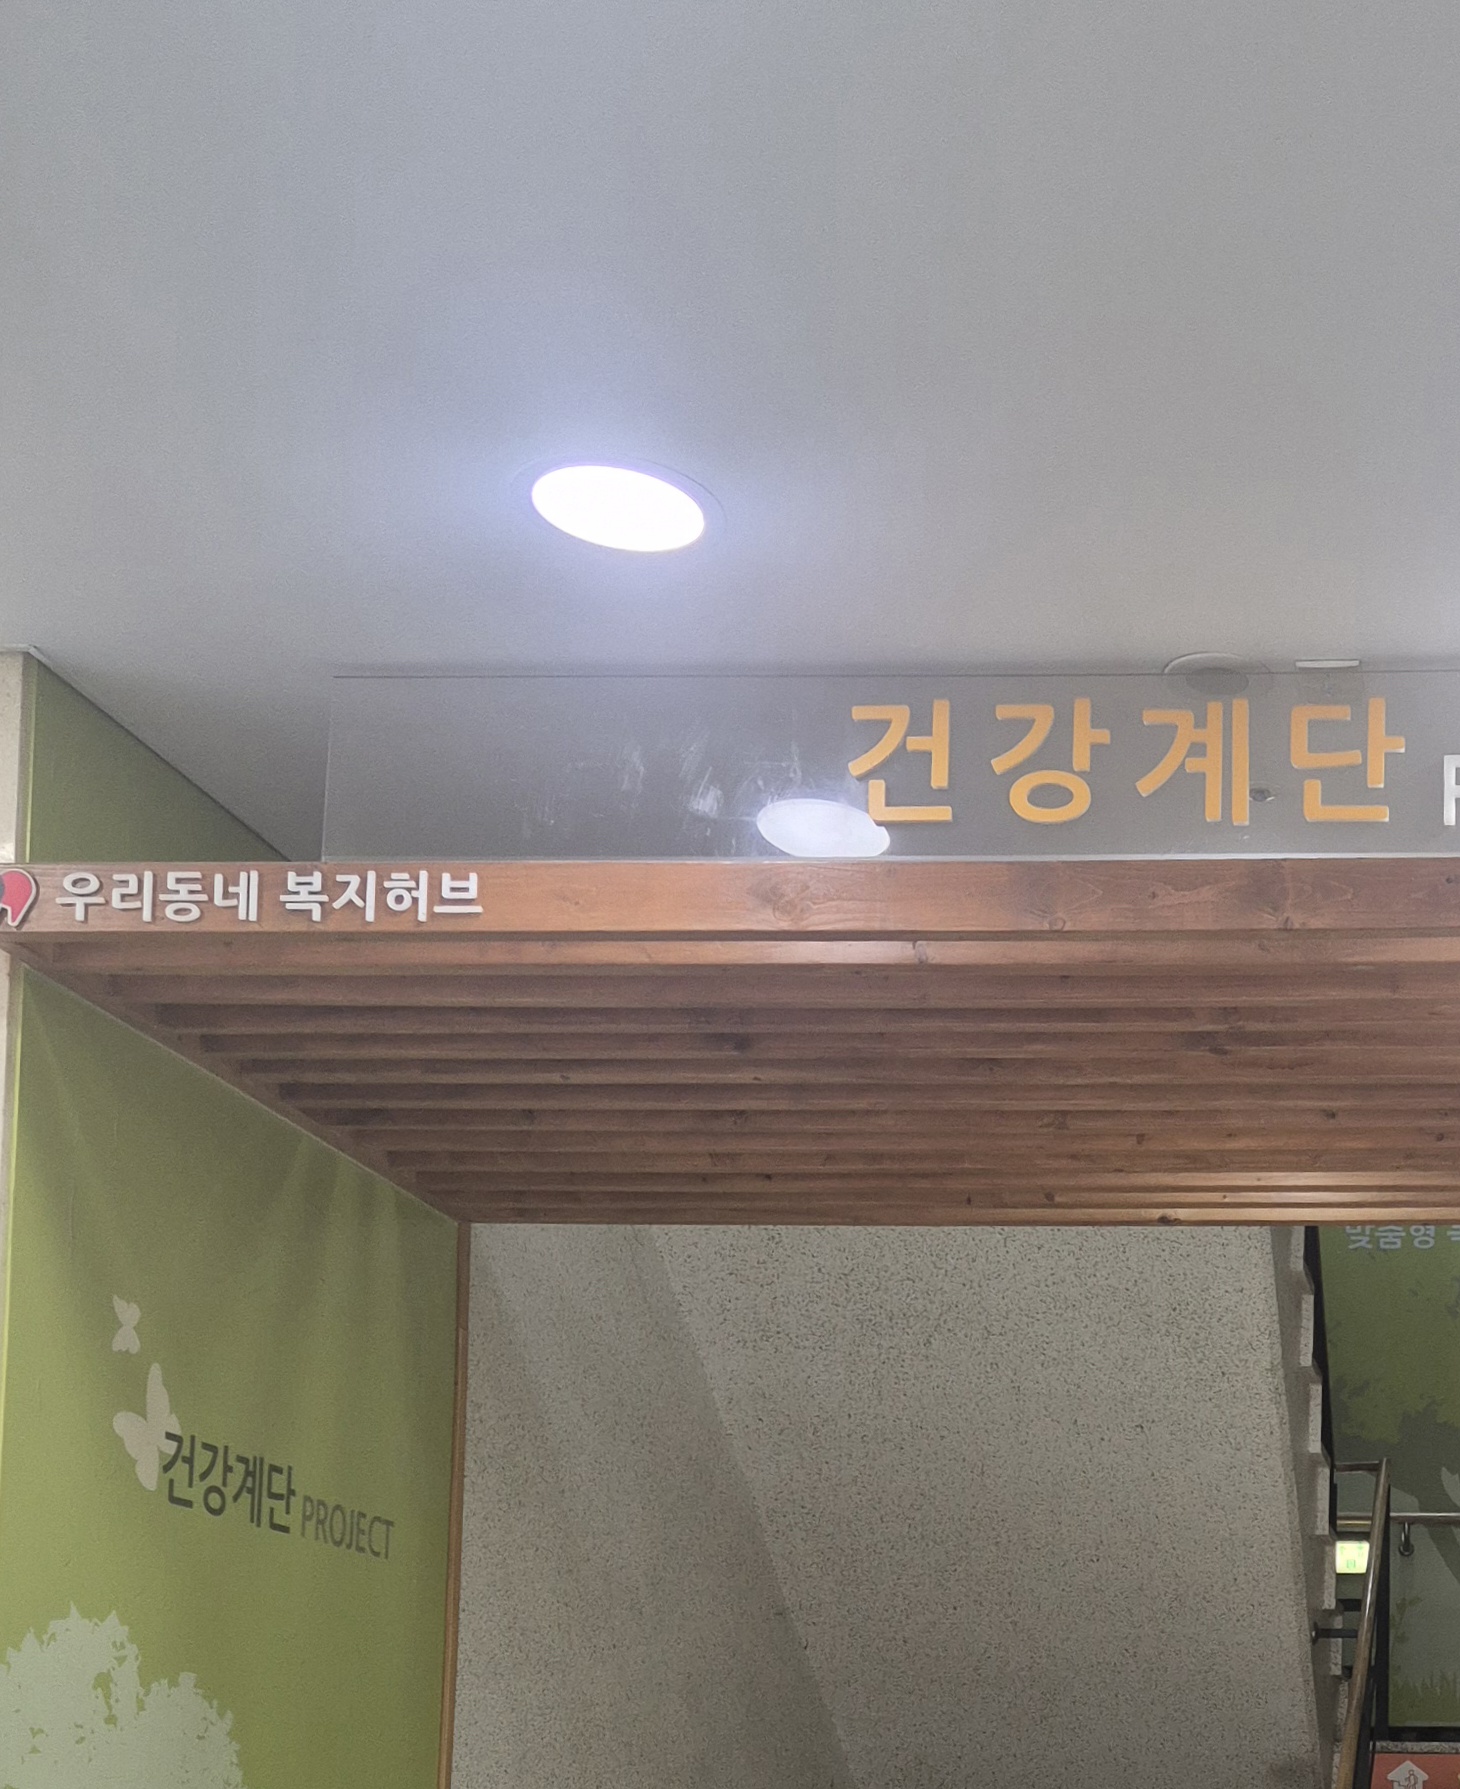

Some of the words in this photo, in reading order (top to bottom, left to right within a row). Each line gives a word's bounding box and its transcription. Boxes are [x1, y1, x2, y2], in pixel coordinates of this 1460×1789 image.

[847, 698, 1405, 826] 건강계단
[56, 871, 260, 924] 우리동네
[279, 871, 484, 923] 복지허브
[162, 1430, 297, 1535] 건강계단
[300, 1494, 396, 1561] PROJECT
